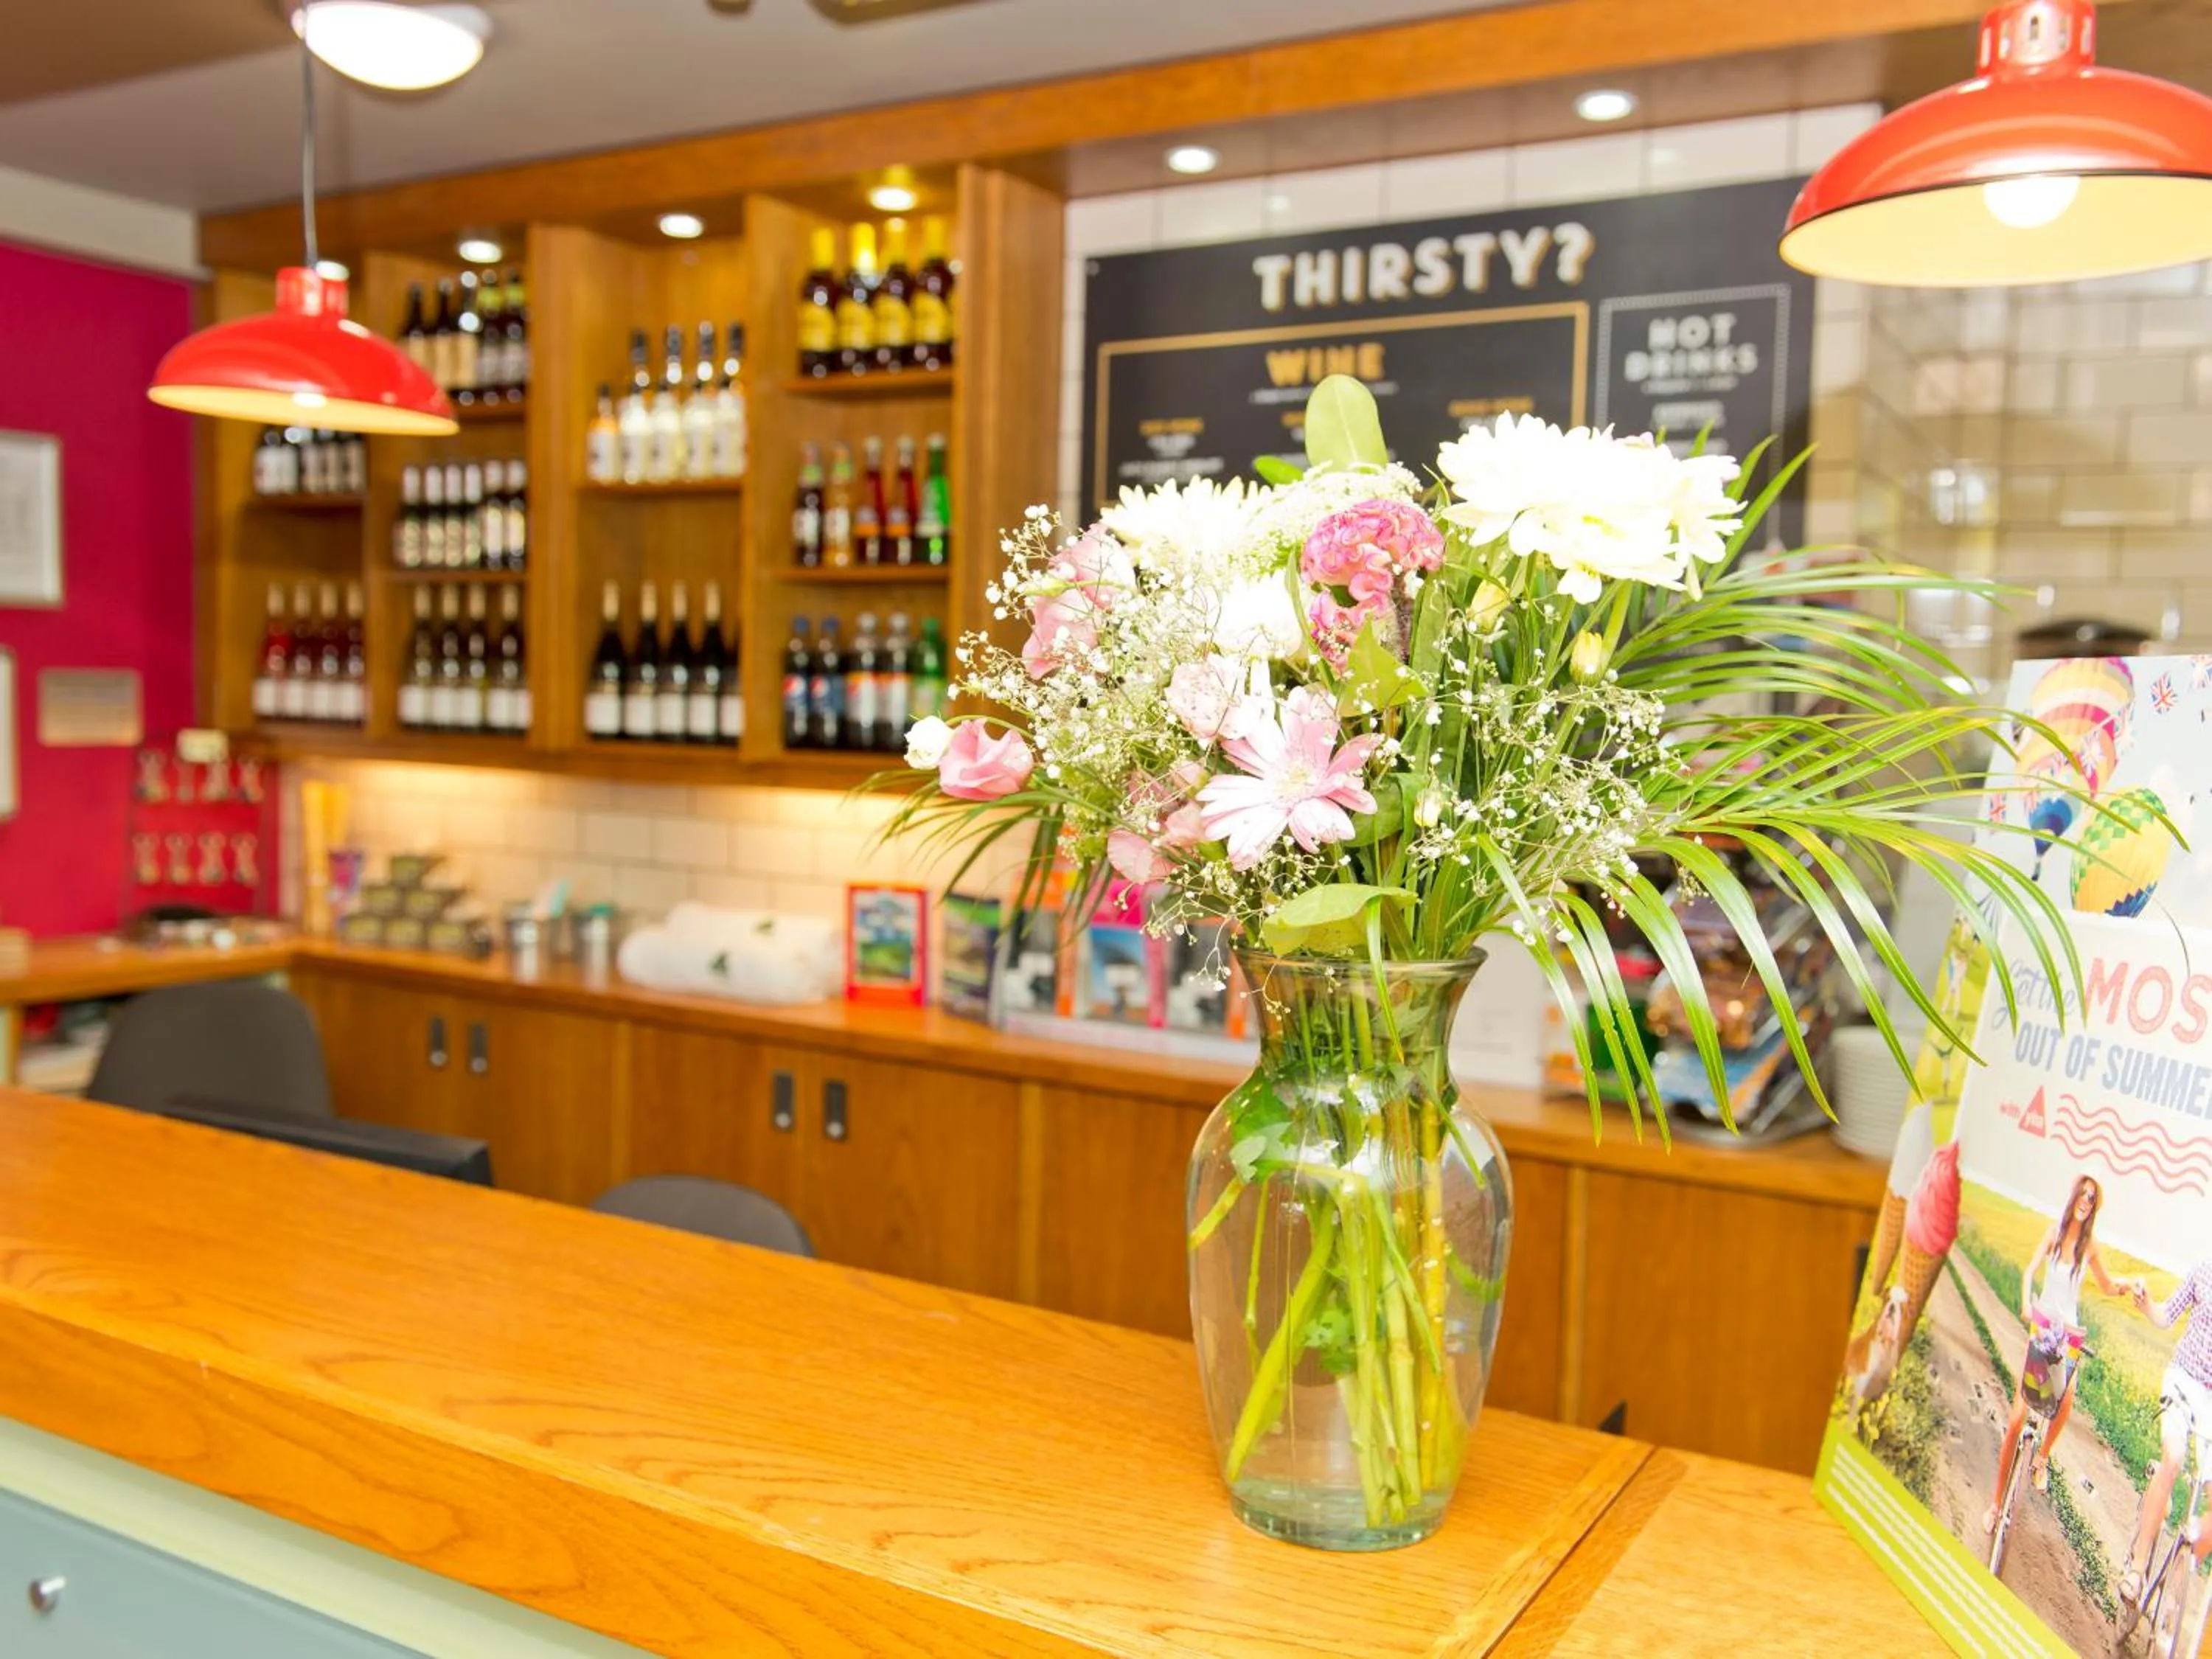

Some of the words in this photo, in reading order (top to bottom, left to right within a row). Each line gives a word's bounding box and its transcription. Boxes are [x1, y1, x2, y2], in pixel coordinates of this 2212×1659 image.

[1253, 221, 1596, 313] THIRSTY?
[1648, 312, 1738, 350] HOT
[1265, 341, 1386, 387] WINE
[1624, 342, 1759, 382] DRINKS
[2014, 1020, 2062, 1072] OUT
[2065, 1034, 2101, 1082] OF
[2101, 1044, 2212, 1121] SUMME
